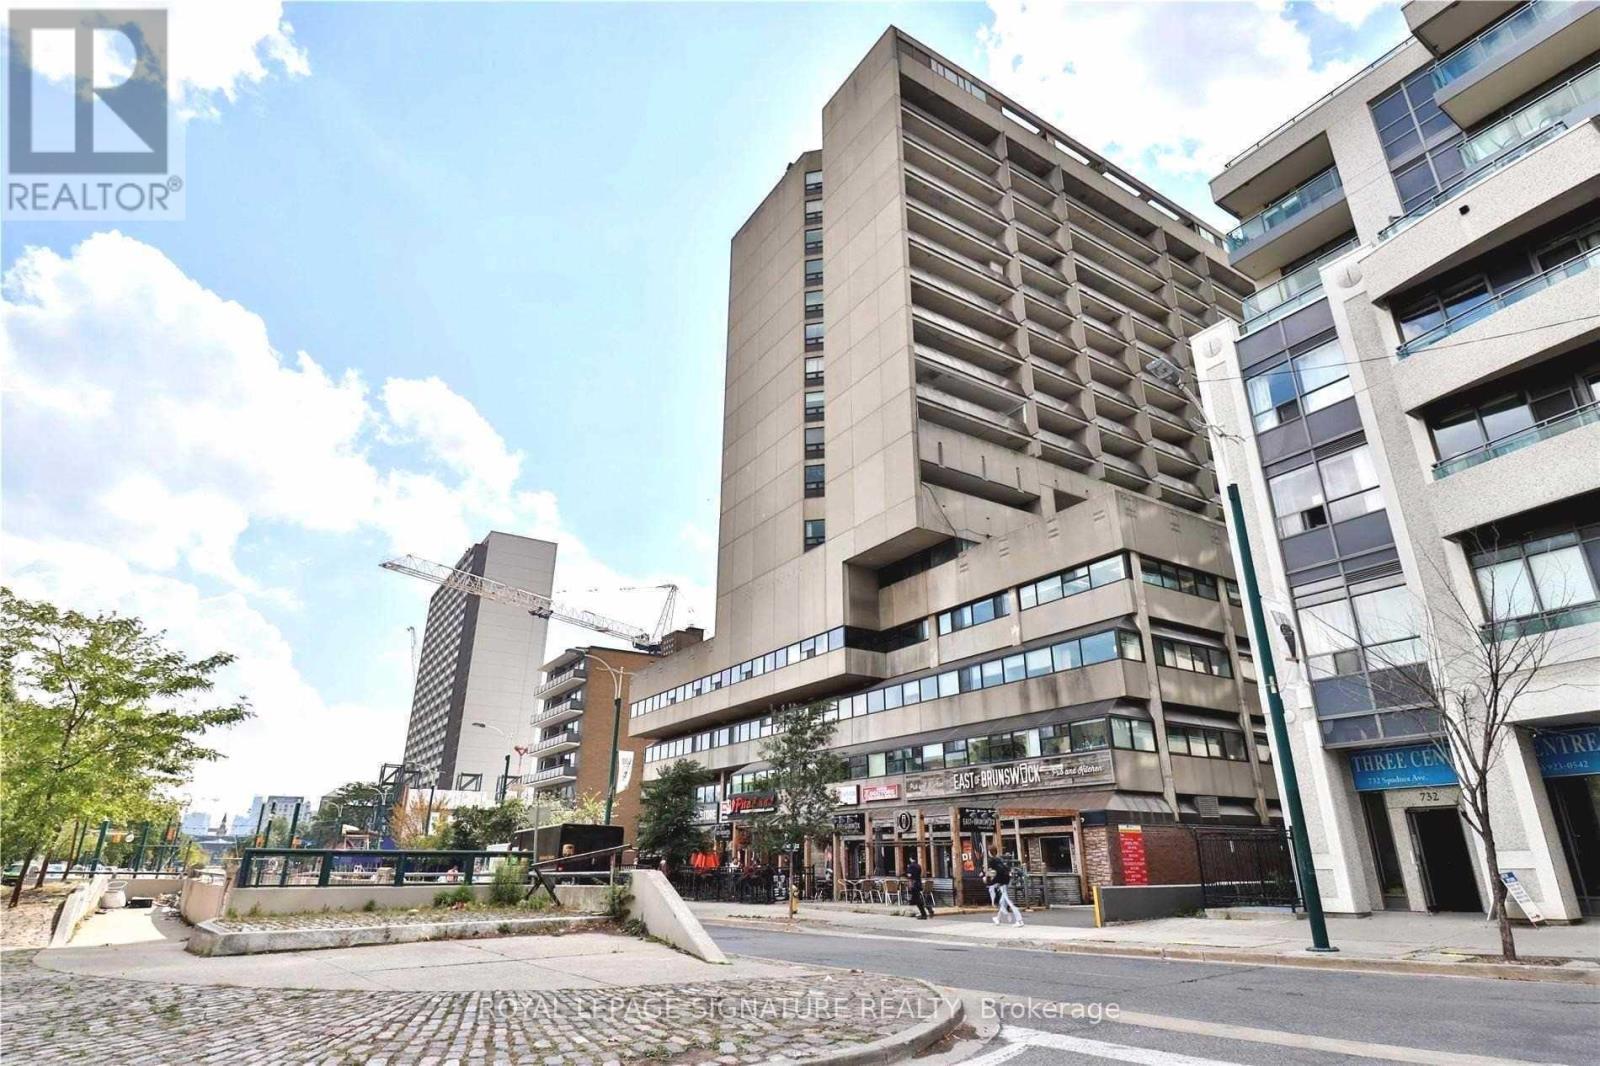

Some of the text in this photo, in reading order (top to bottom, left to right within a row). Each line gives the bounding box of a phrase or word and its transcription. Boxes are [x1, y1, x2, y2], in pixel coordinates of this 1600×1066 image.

[1352, 751, 1407, 773] THREE
[953, 772, 975, 790] EAST
[1420, 793, 1440, 801] 732
